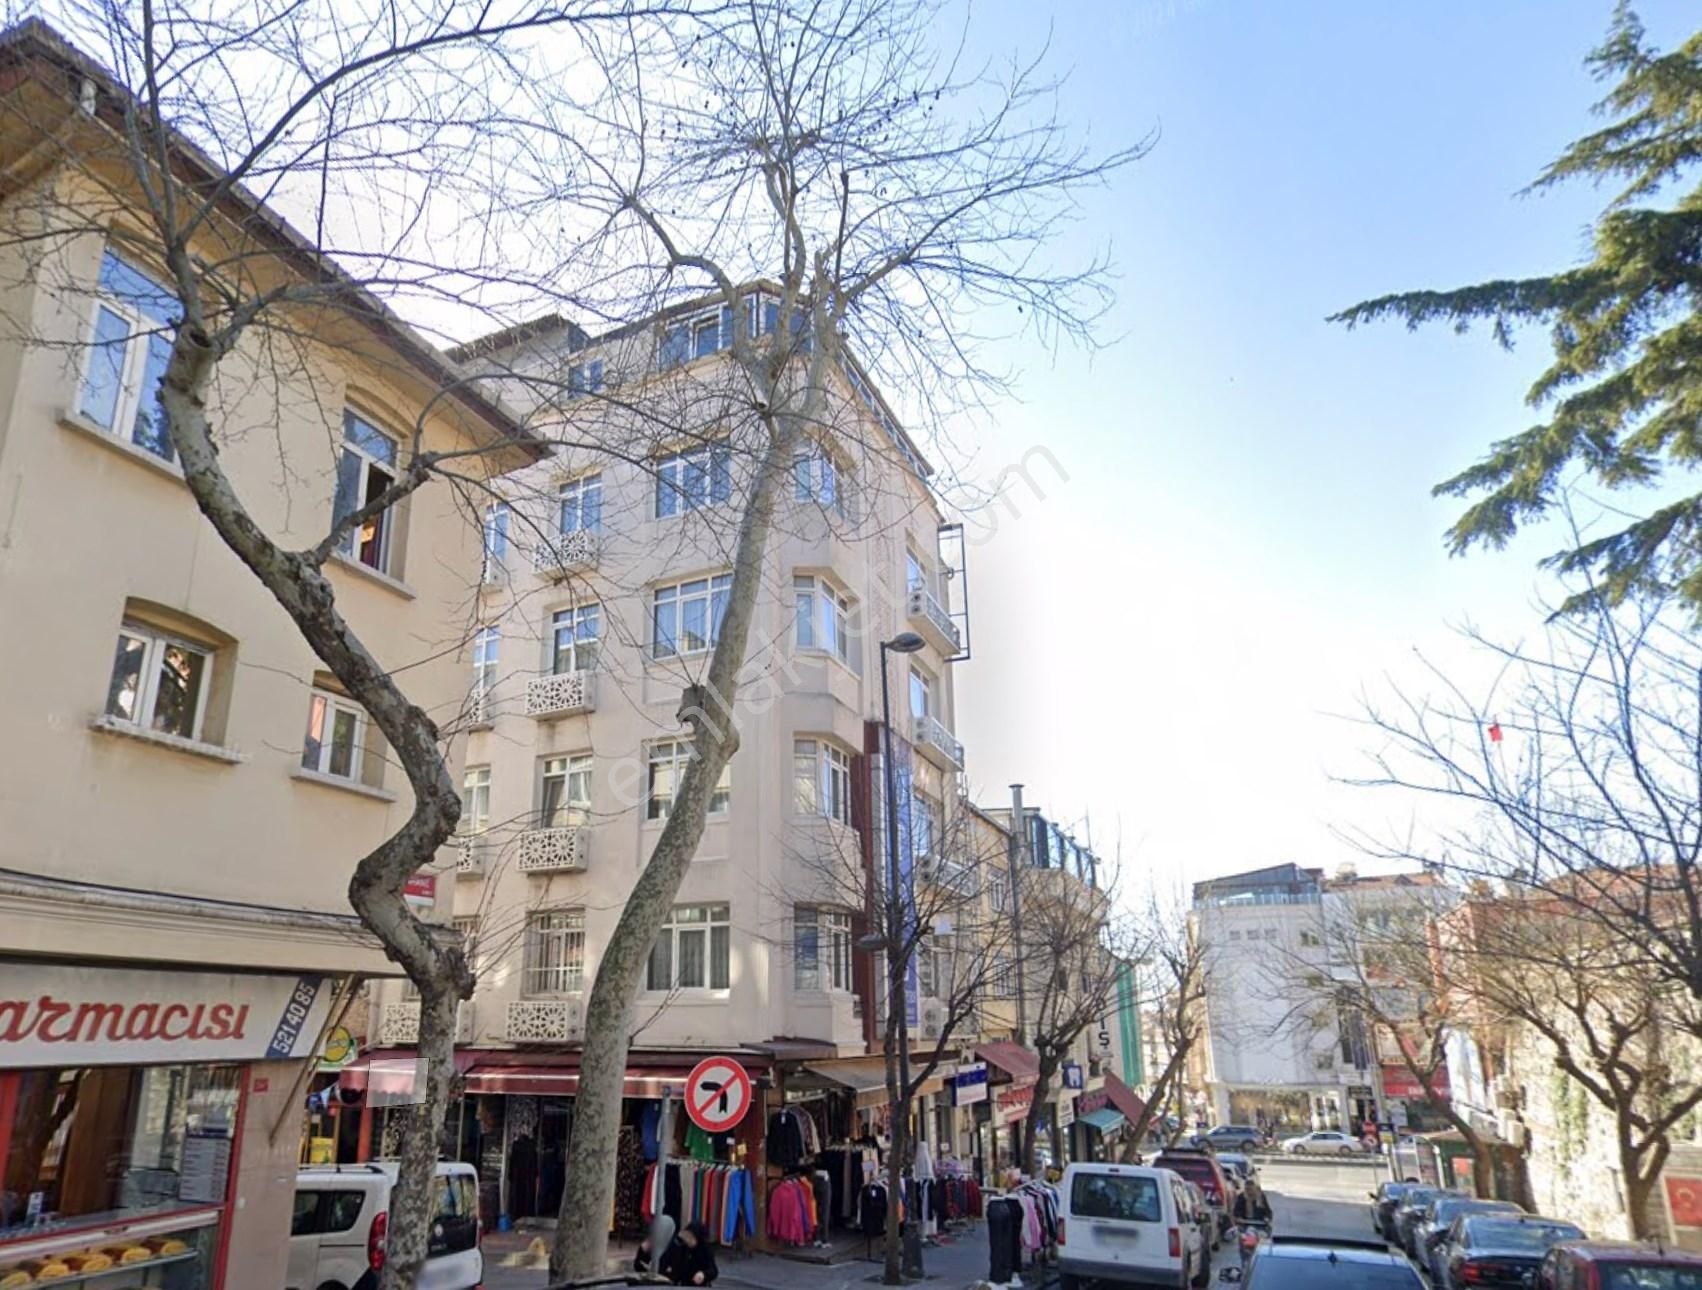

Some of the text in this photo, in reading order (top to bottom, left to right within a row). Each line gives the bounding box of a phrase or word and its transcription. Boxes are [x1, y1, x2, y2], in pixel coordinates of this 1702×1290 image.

[273, 982, 316, 1053] 521 40 85
